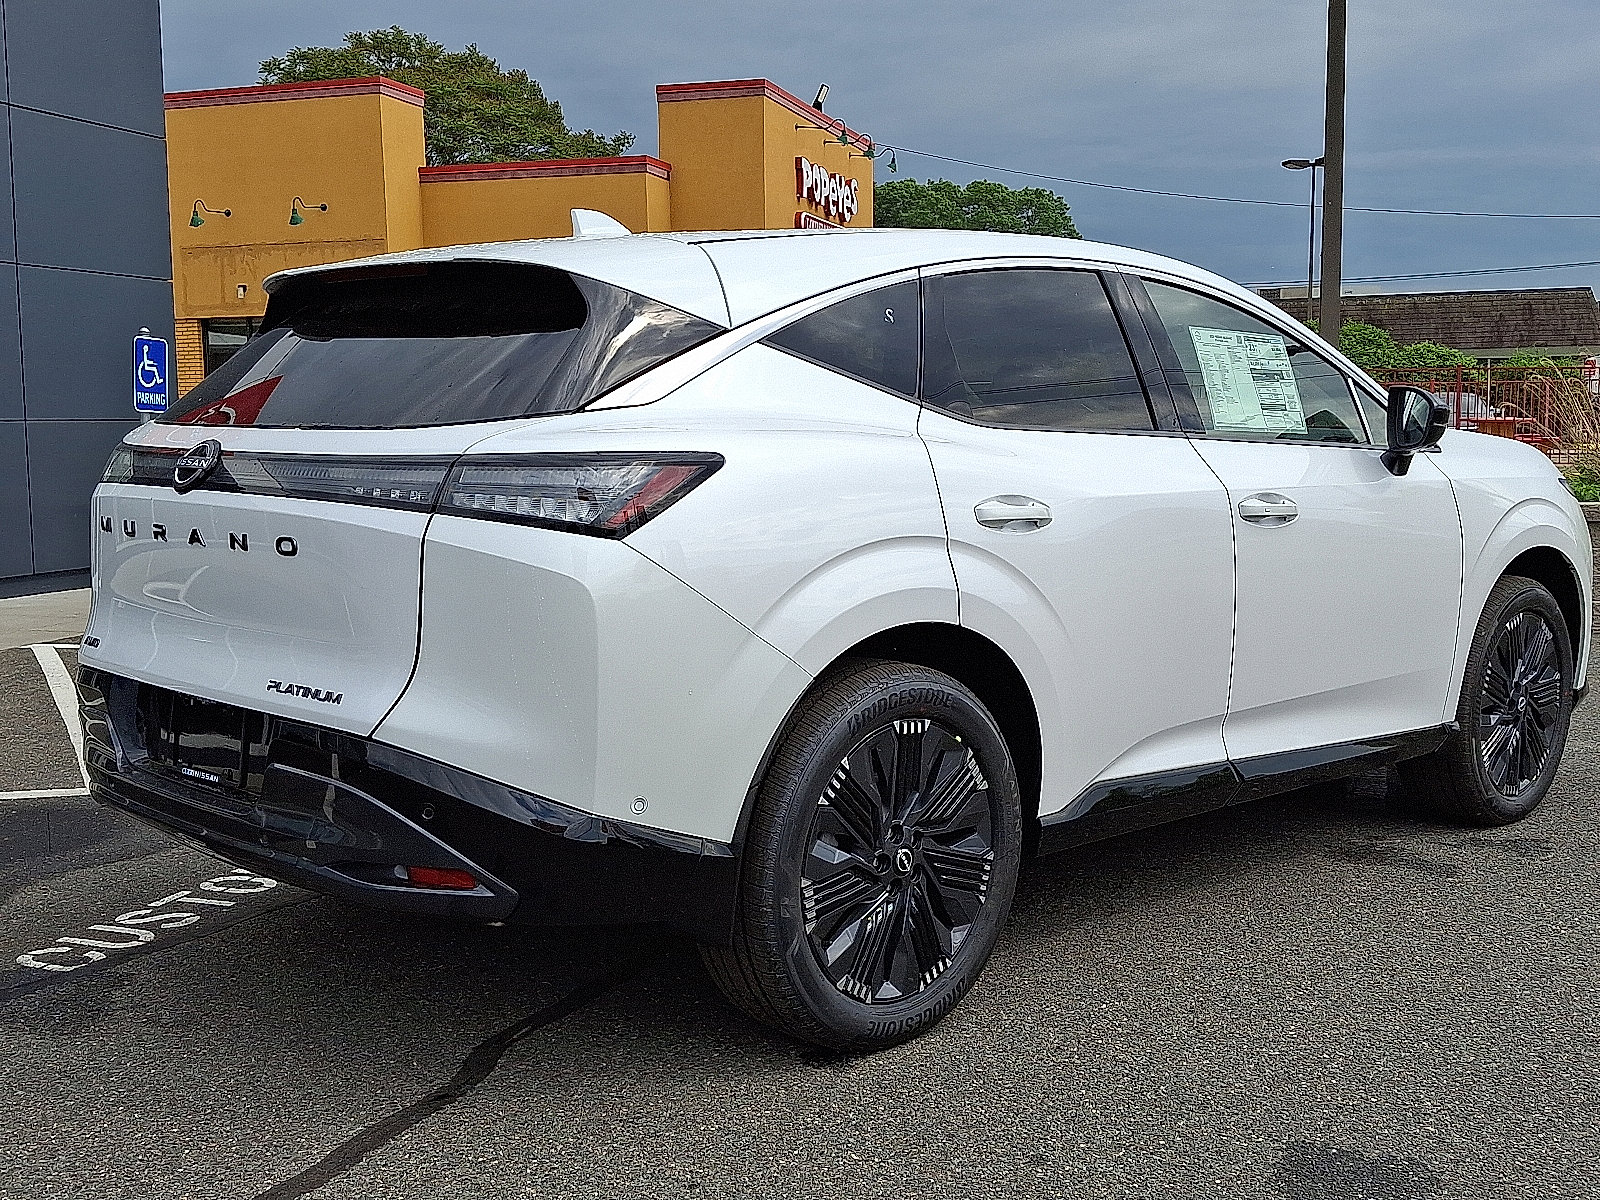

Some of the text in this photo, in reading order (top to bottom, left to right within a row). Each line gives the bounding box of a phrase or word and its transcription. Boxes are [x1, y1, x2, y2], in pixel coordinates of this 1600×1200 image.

[137, 391, 166, 405] PARKING
[176, 458, 210, 468] NISSAN
[100, 515, 299, 557] MURANO
[266, 679, 344, 705] PLATINUM
[846, 687, 955, 736] BRIDGESTONE
[16, 868, 277, 972] CUSTO
